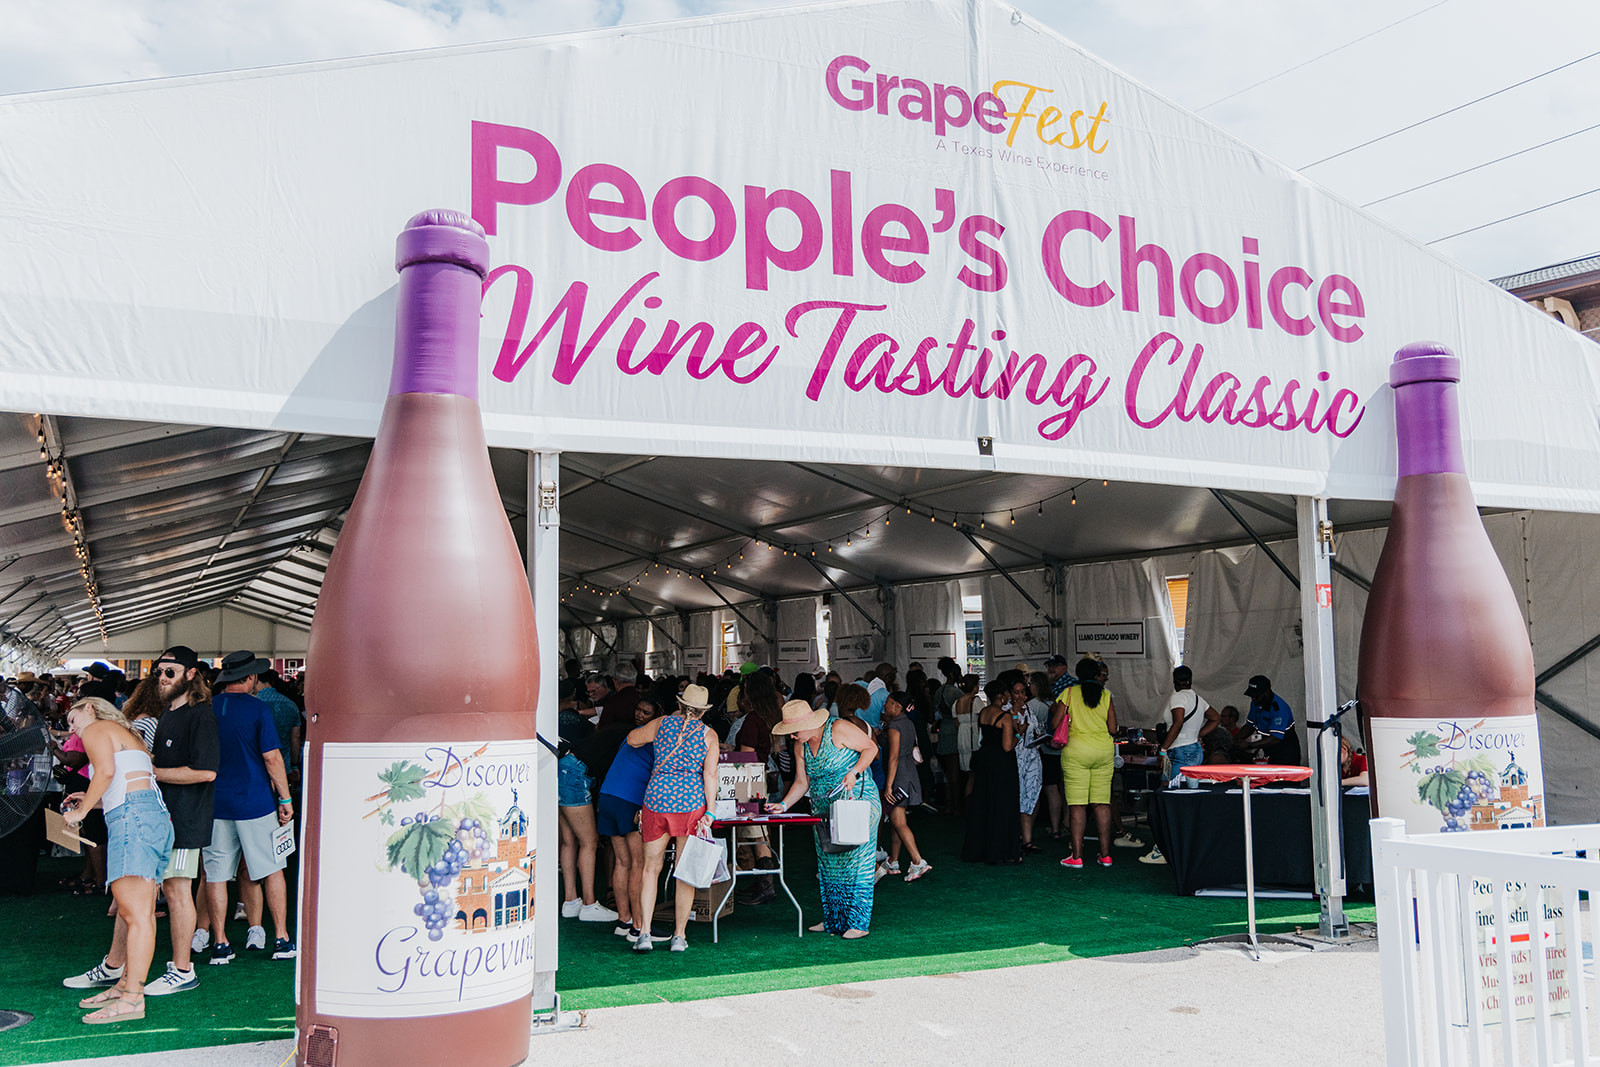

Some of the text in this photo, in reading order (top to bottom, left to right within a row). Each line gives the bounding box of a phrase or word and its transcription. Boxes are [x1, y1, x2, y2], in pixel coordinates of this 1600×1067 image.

[935, 138, 1109, 181] A Texas Wine Experience
[470, 120, 1366, 343] People's Choice
[480, 264, 1366, 440] Wine Tasting Classic
[1078, 633, 1140, 641] LLANO ESTACADO WINERY
[1437, 721, 1526, 750] Discover
[423, 746, 530, 788] Discover
[1476, 910, 1495, 927] ine
